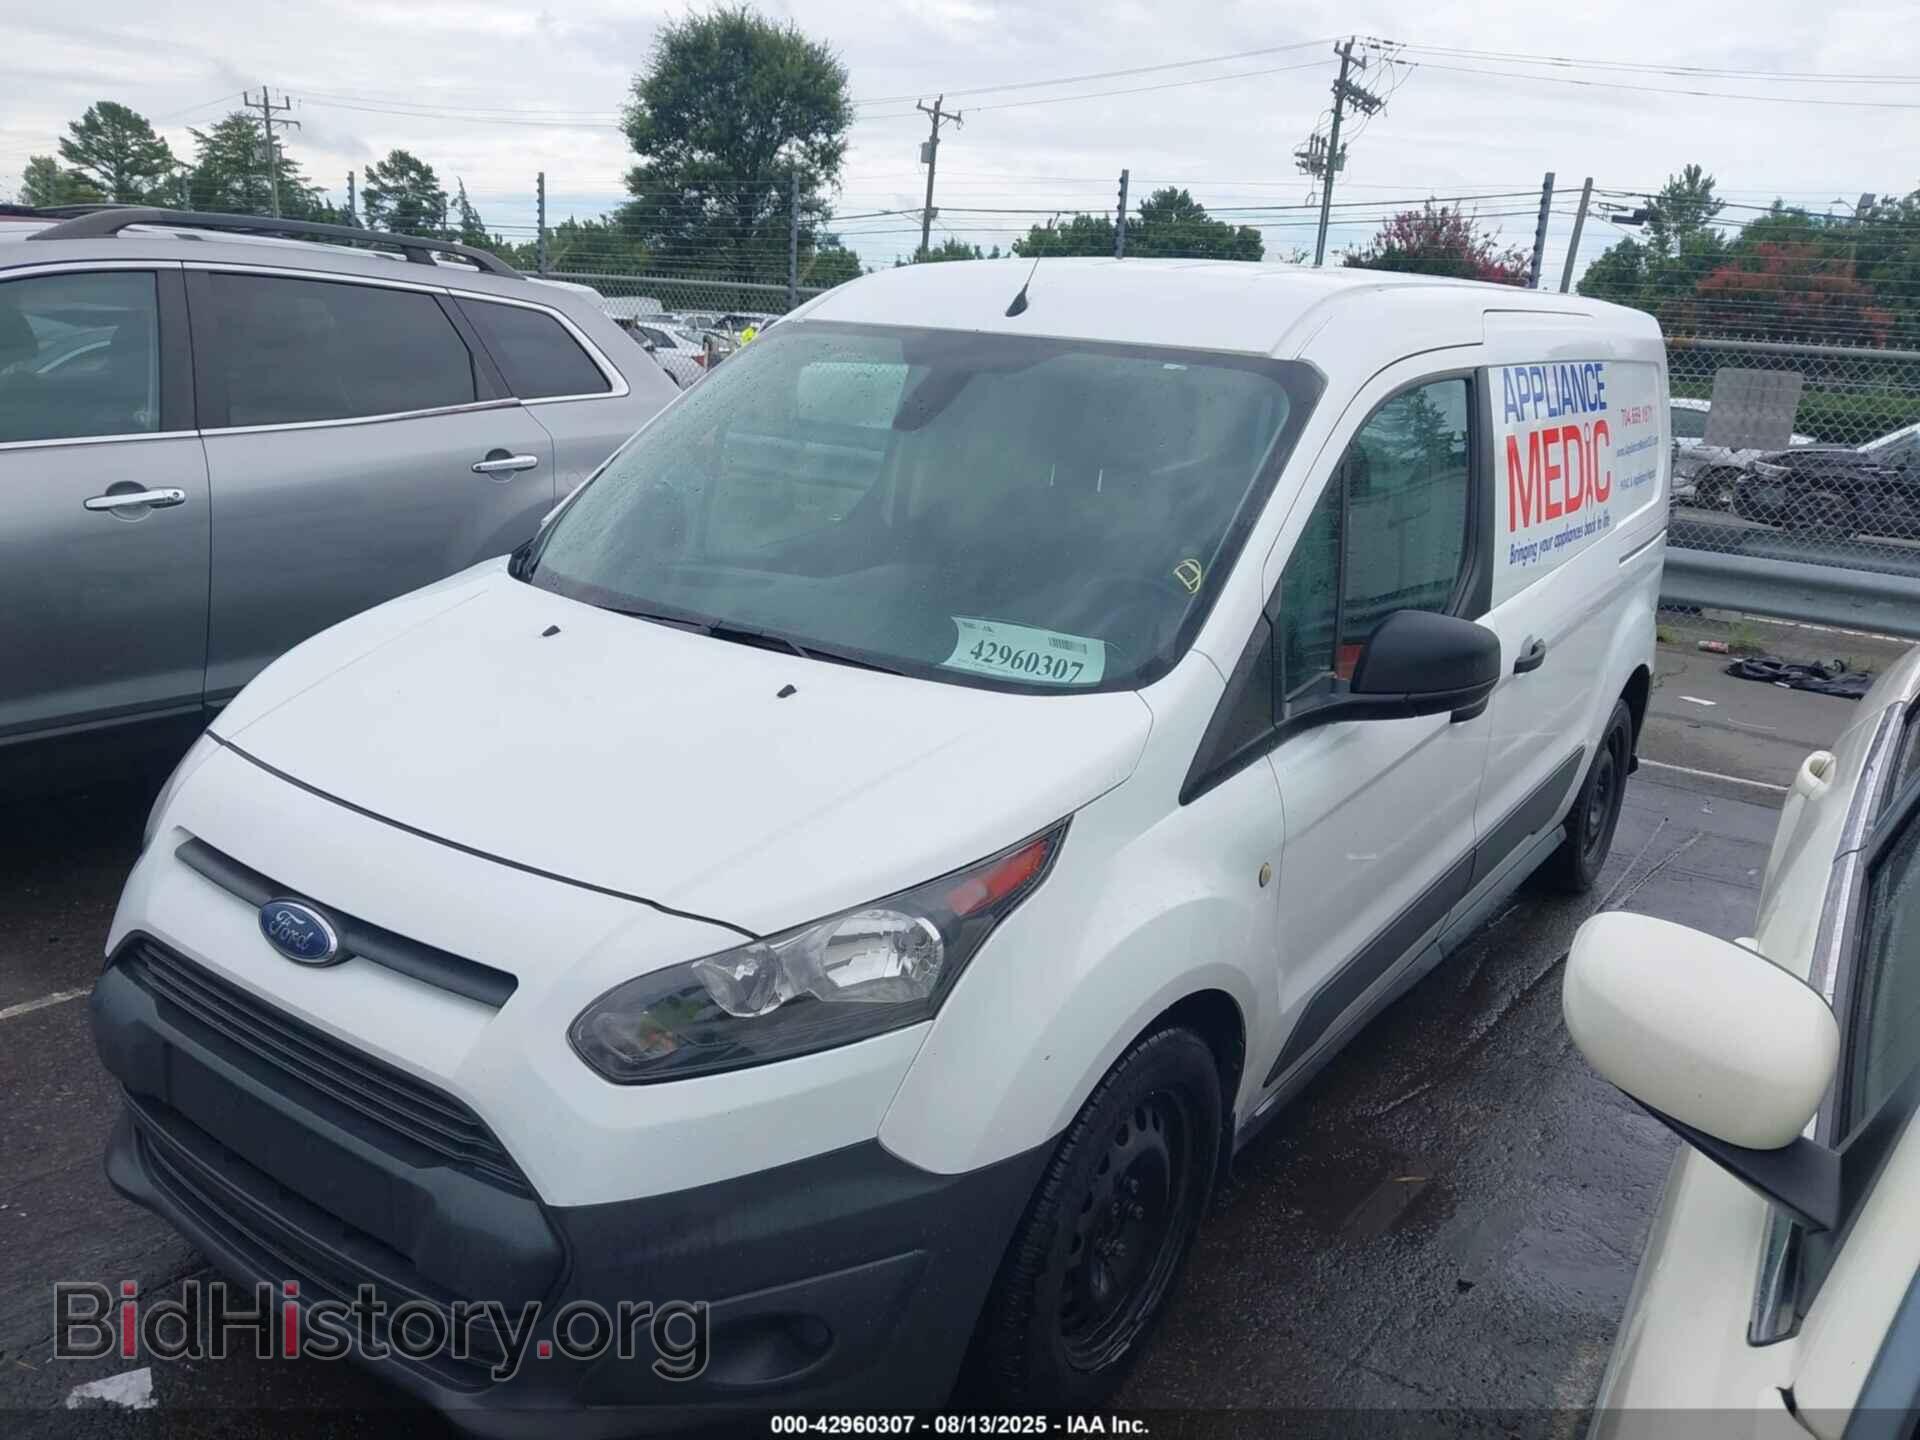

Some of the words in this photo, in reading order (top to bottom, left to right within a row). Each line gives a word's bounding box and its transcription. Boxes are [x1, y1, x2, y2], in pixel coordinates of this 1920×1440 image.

[1503, 363, 1607, 424] APPLIANCE
[1510, 538, 1538, 566] Bringing
[1537, 535, 1554, 560] your
[1553, 523, 1584, 553] appliances
[1583, 513, 1597, 537] back
[1602, 507, 1611, 529] life
[970, 639, 1085, 683] 42960307
[269, 910, 315, 950] Ford
